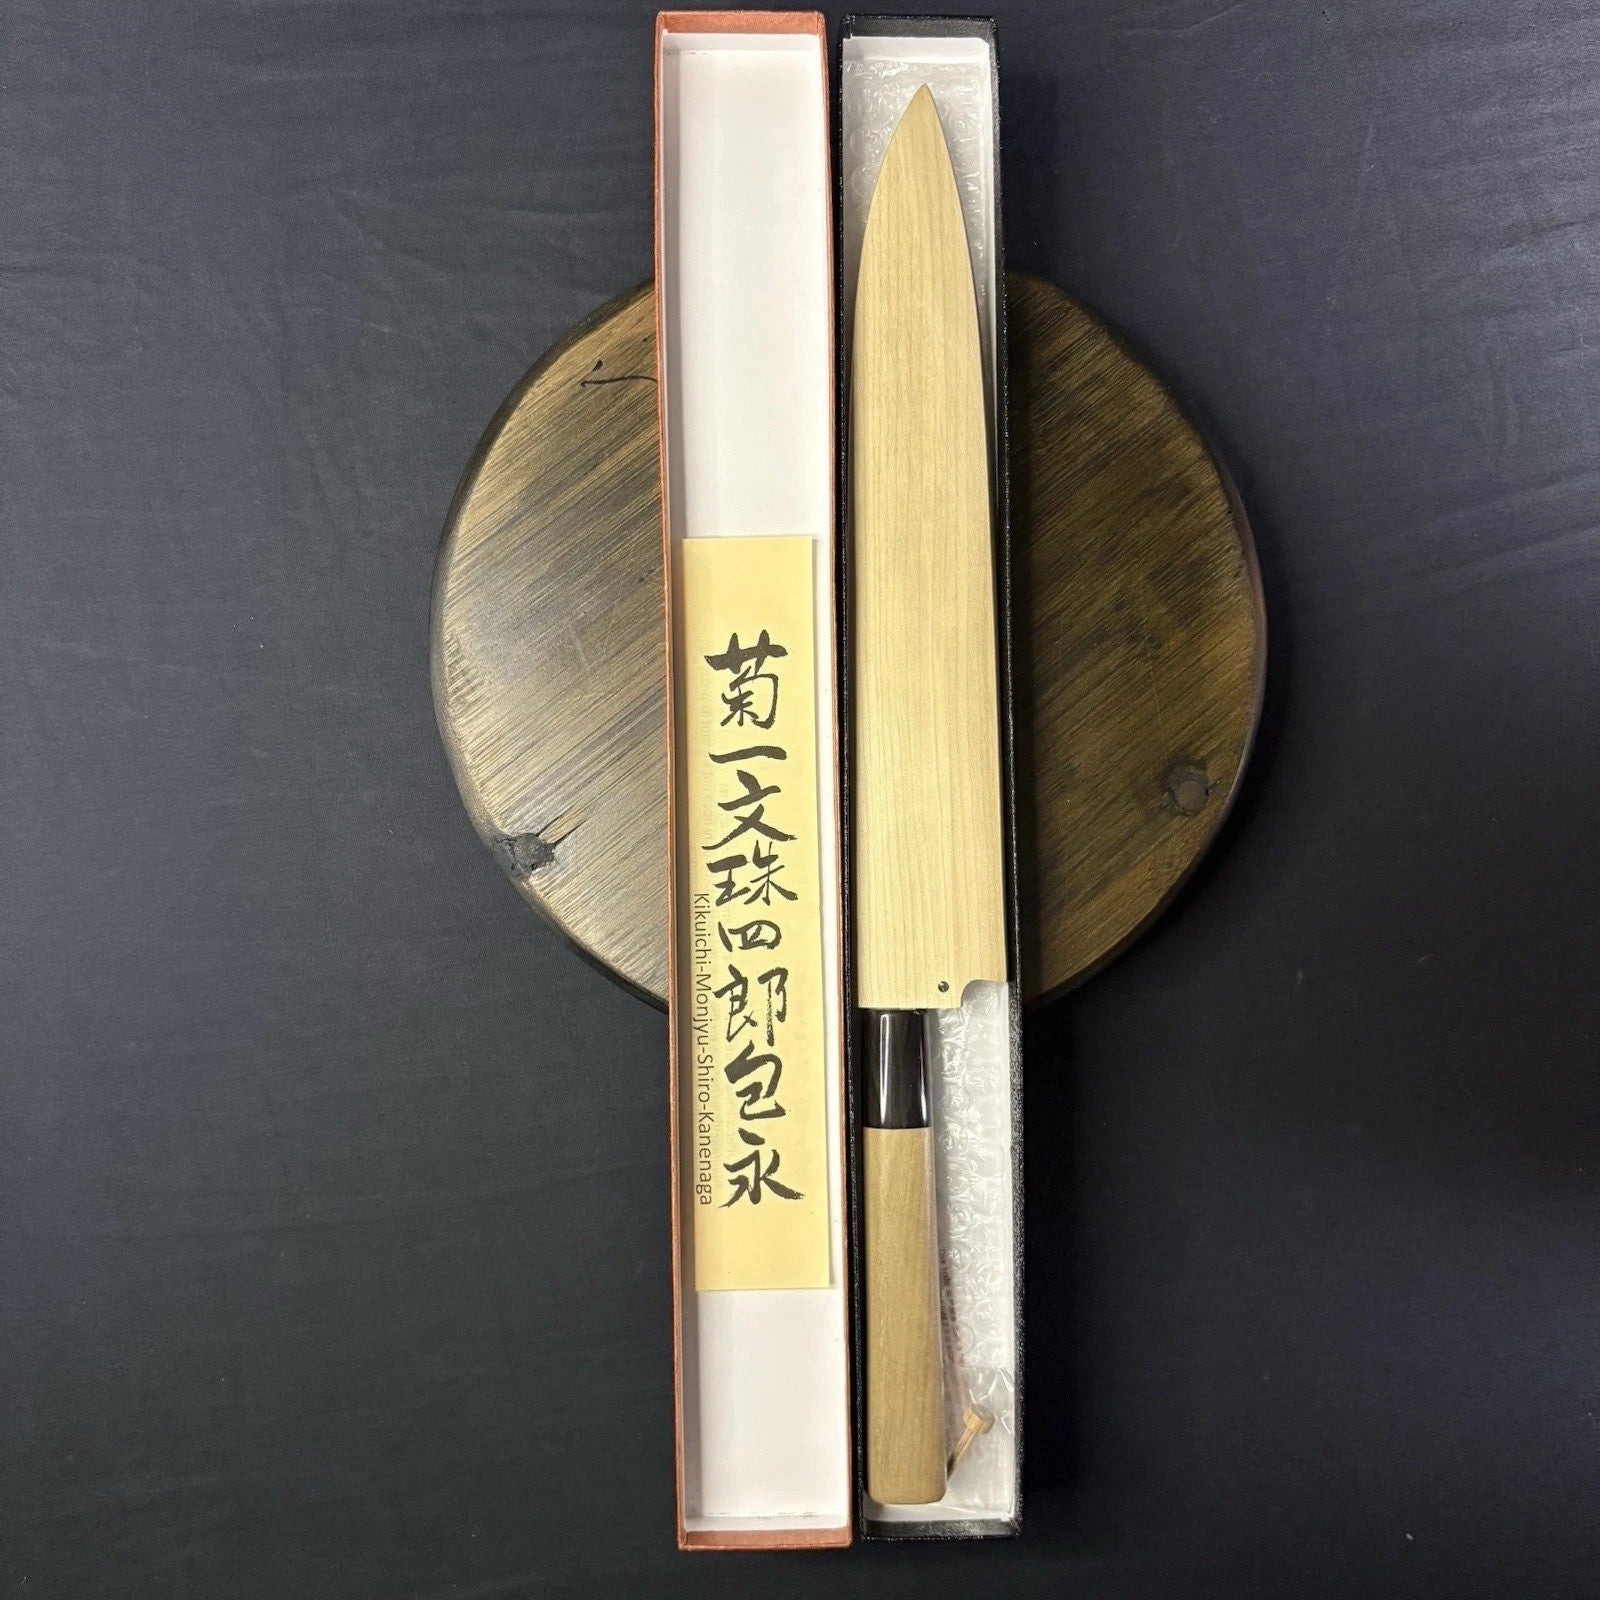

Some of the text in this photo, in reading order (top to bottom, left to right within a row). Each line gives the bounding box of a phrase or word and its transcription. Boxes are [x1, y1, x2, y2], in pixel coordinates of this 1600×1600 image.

[693, 893, 715, 1205] Kikuichi-Monjyu-Shiro-Kanenaga
[702, 629, 804, 1208] 菊一文珠四郎包永
